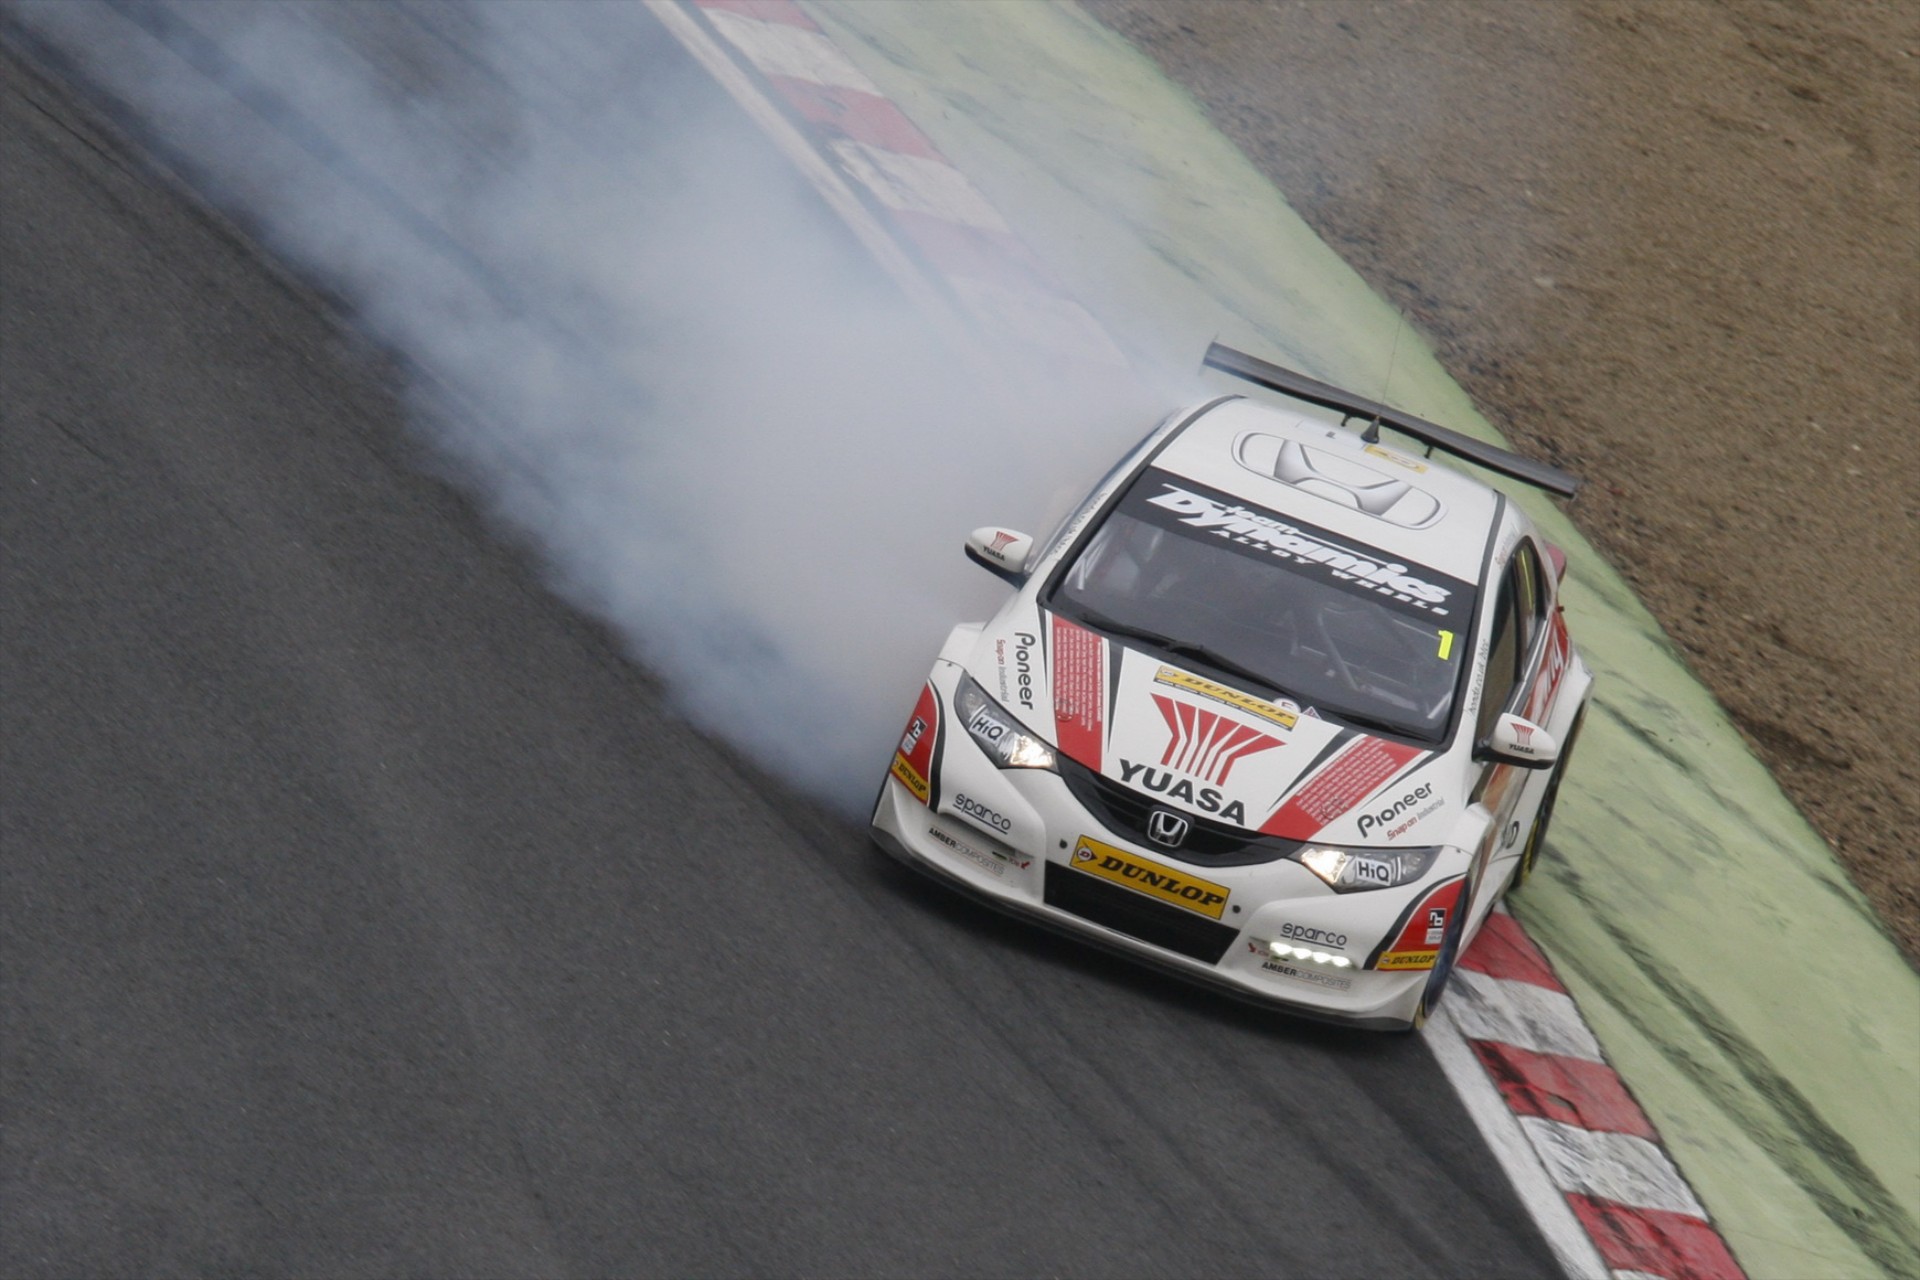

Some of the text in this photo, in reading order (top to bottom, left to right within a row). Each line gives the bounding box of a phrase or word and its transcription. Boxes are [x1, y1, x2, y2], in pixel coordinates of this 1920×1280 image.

[983, 546, 1005, 562] YUASA
[1147, 483, 1451, 603] Dynamics
[1211, 529, 1449, 615] ALLOY WHEELS
[1438, 629, 1454, 660] 1
[1014, 632, 1036, 710] Pioneer
[1184, 676, 1295, 720] DUNLOP
[972, 716, 1004, 742] HiQ
[1509, 742, 1535, 755] YUASA
[898, 757, 927, 793] DUNLOP
[1119, 758, 1245, 827] YUASA
[955, 793, 1012, 831] sparco
[1357, 782, 1433, 838] Pioneer
[1098, 855, 1225, 906] DUNLOP
[1358, 861, 1390, 883] HiQ
[1282, 921, 1348, 946] sparco
[1391, 954, 1436, 965] DUNLOP
